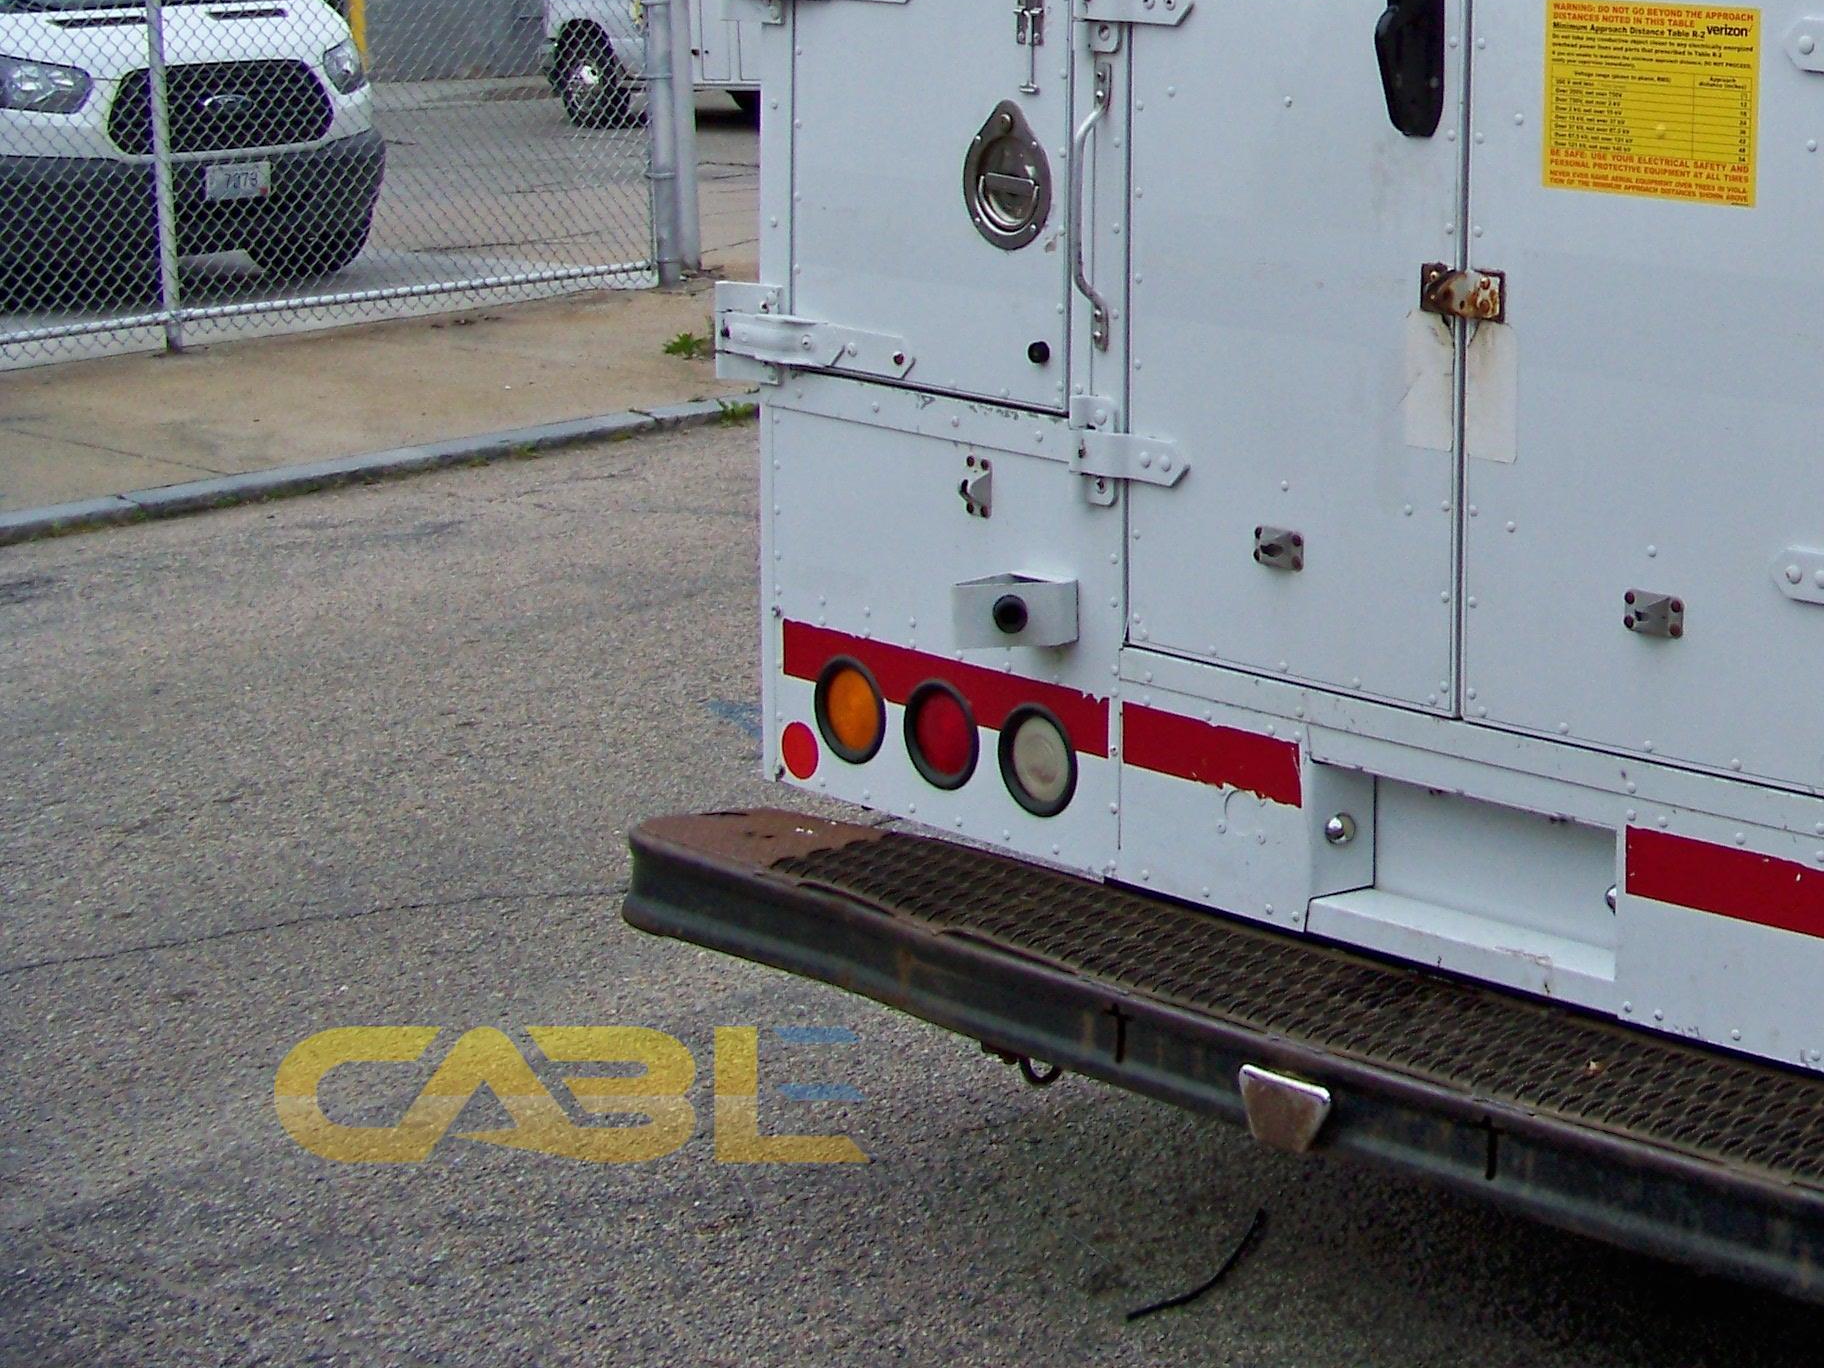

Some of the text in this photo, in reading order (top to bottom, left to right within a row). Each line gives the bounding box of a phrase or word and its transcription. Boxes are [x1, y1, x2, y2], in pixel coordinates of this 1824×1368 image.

[1553, 2, 1596, 11] WARNING:
[1647, 8, 1682, 17] BEYOND
[1686, 10, 1702, 18] THE
[1705, 11, 1753, 21] APPROACH
[1553, 11, 1695, 27] DISTANCES NOTED IN THIS TABLE
[1552, 21, 1587, 30] Minimum
[1590, 24, 1627, 35] Approach
[1630, 27, 1664, 35] Distance
[1667, 29, 1689, 37] Table
[1706, 22, 1748, 37] verizon
[1550, 148, 1560, 156] BE
[1591, 152, 1607, 160] USE
[1612, 154, 1633, 162] YOUR
[1637, 156, 1689, 168] ELECTRICAL
[1693, 161, 1726, 170] SAFETY
[1730, 164, 1748, 172] AND
[1550, 158, 1589, 168] PERSONAL
[1592, 161, 1640, 173] PROTECTIVE
[1643, 166, 1689, 177] EQUIPMENT
[1706, 172, 1719, 180] ALL
[1724, 174, 1748, 183] TIMES
